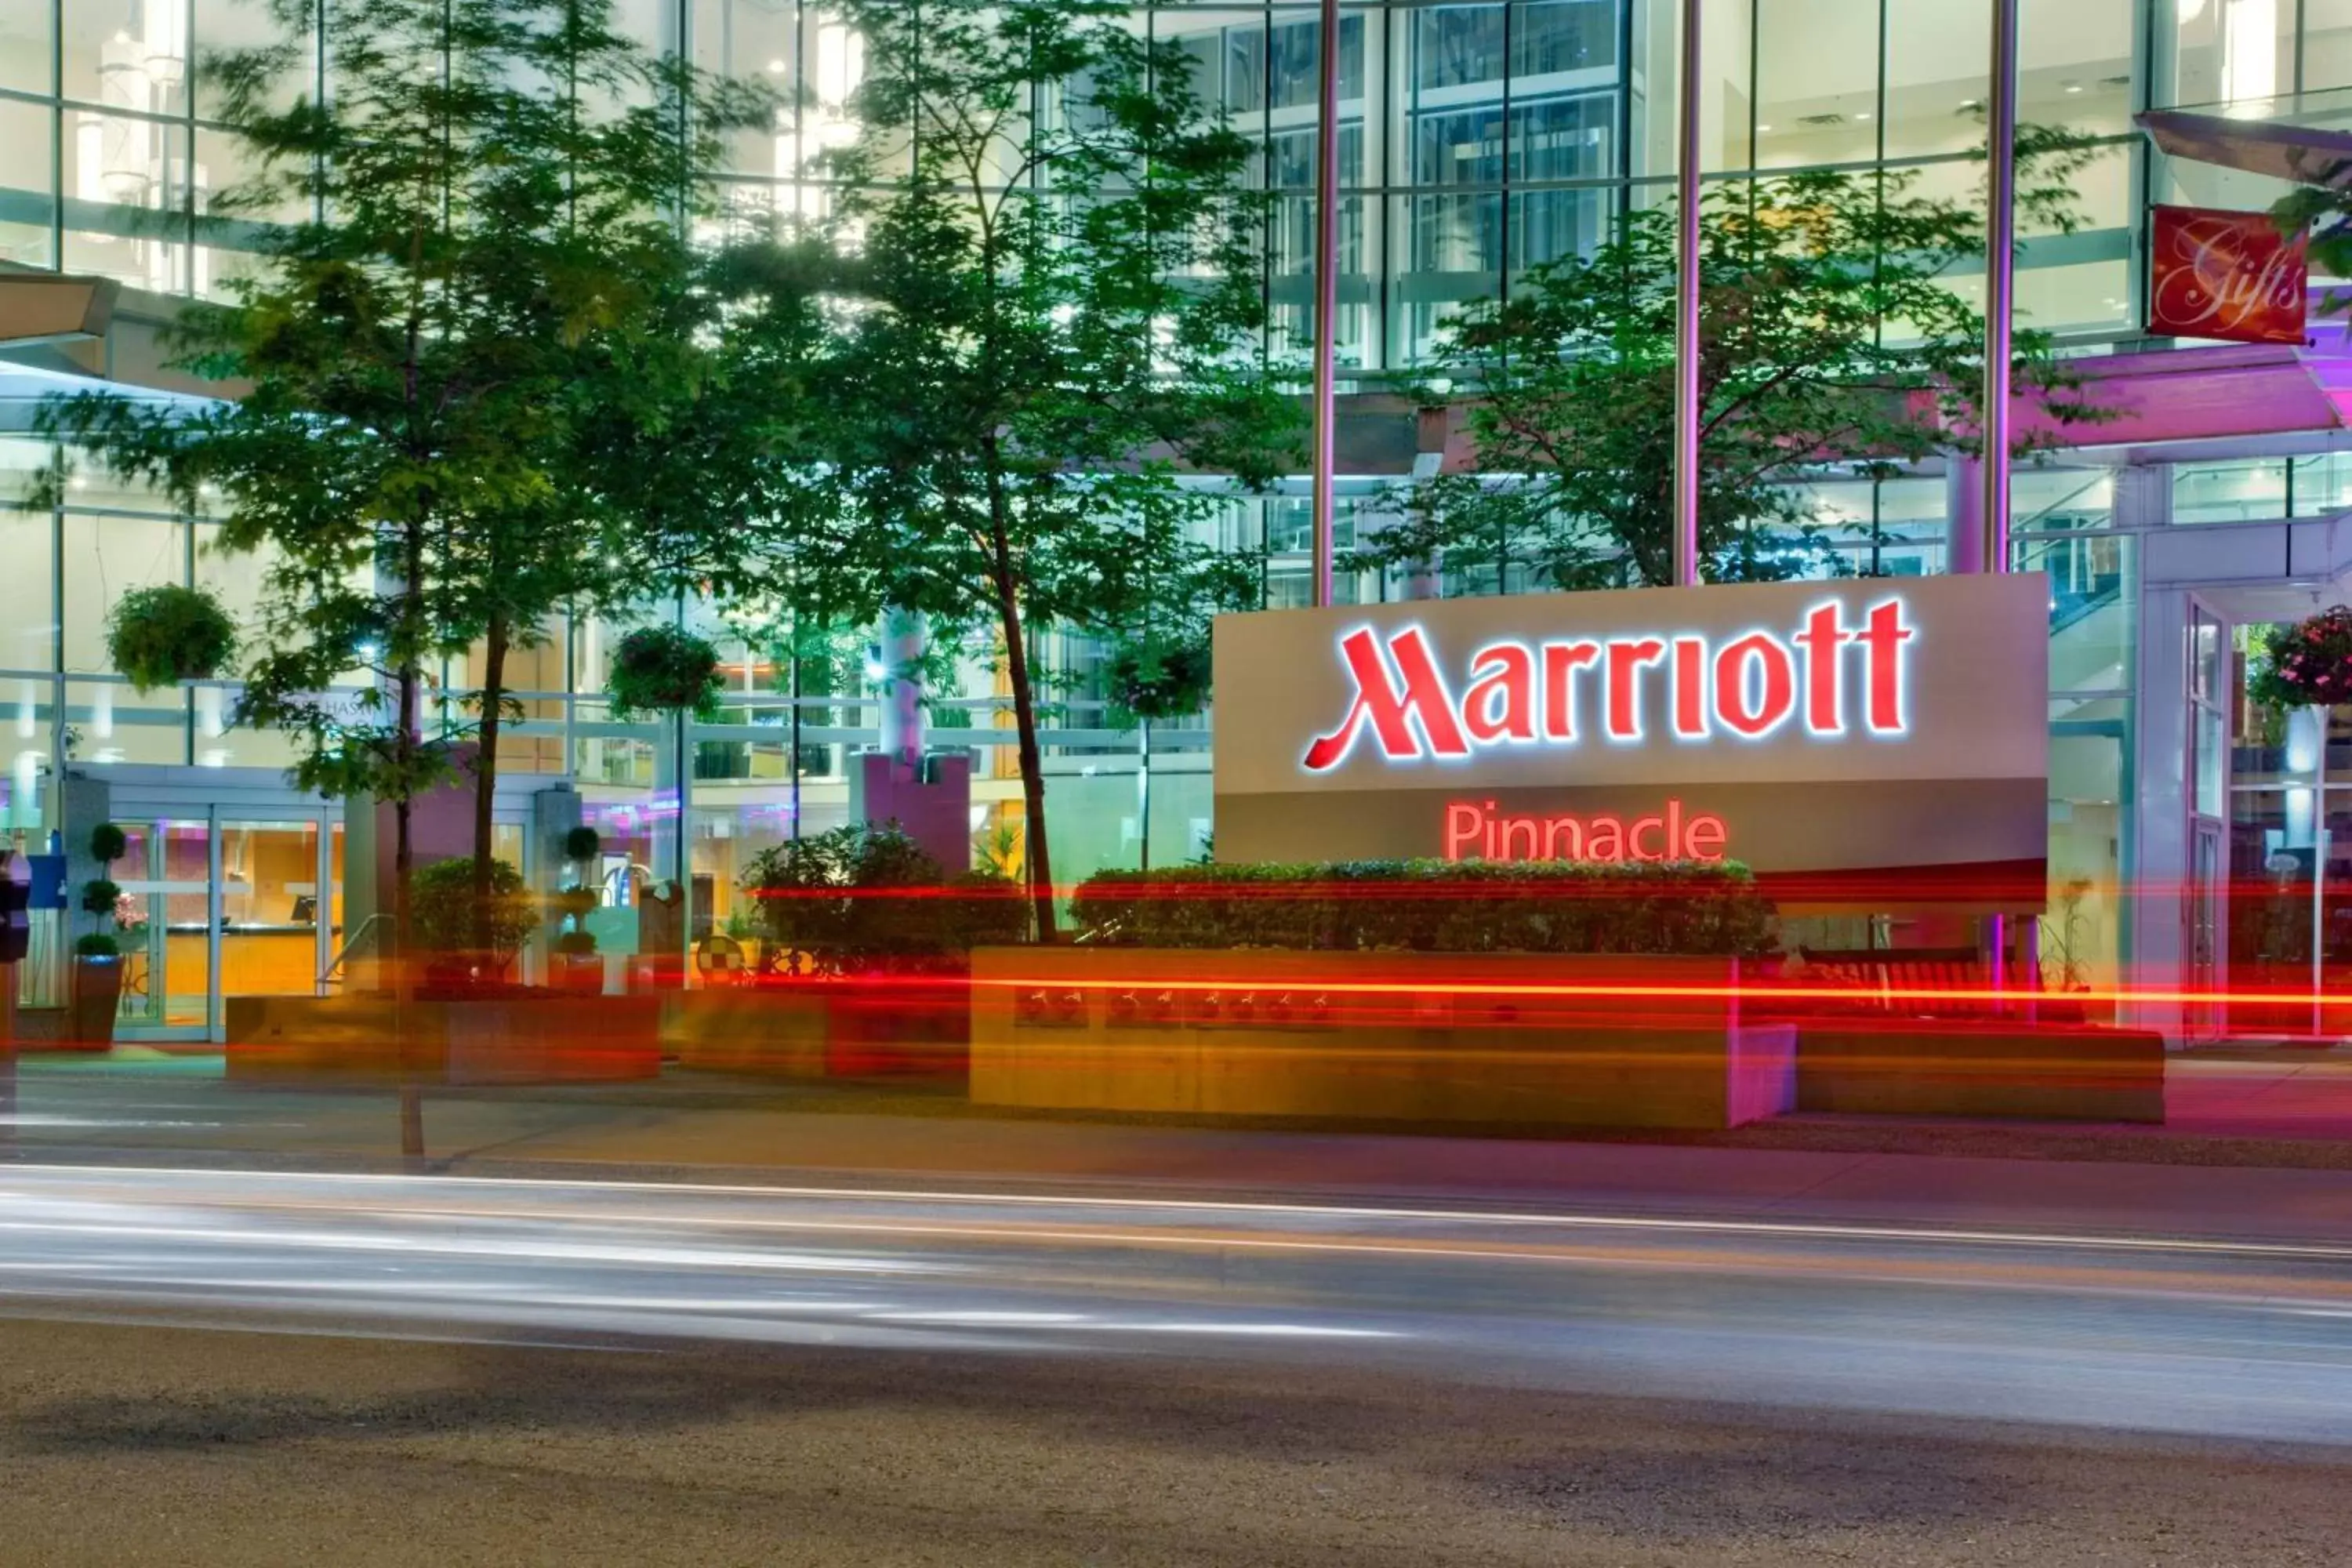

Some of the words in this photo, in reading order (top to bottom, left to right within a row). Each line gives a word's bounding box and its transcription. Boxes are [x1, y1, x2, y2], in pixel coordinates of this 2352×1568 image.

[2156, 217, 2303, 332] Gifts
[1302, 599, 1913, 771] Marriott
[1446, 799, 1728, 862] Pinnacle
